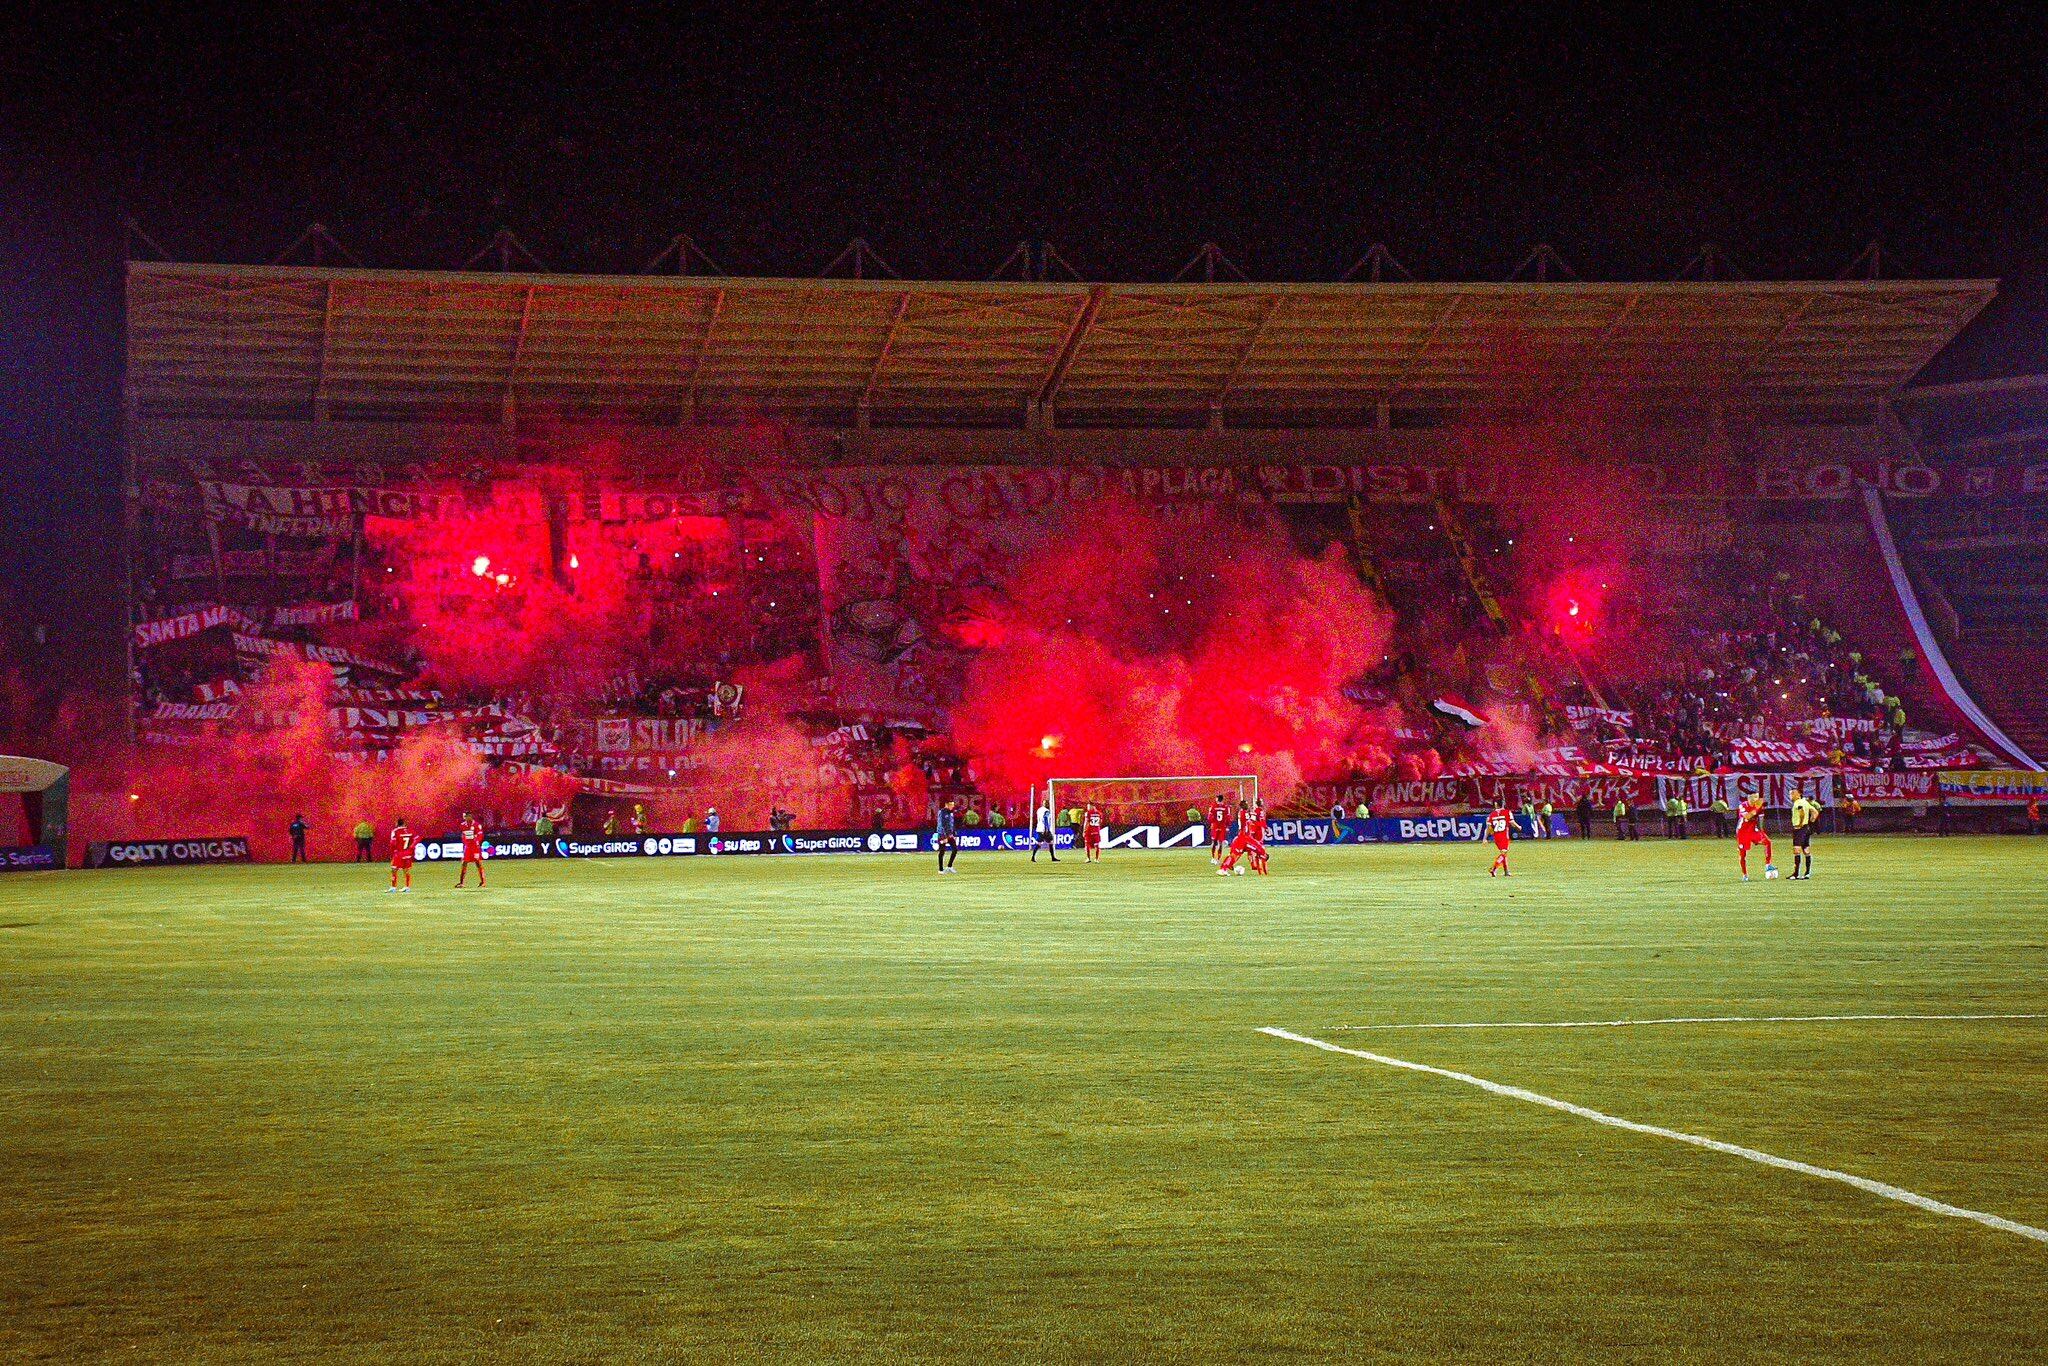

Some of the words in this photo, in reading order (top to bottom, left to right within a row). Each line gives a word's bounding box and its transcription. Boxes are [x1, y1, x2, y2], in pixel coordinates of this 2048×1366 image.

[1142, 467, 1234, 495] PLAGA
[136, 612, 201, 648] SANTA
[1372, 780, 1457, 805] CANCHAS
[1666, 777, 1728, 808] NADA
[1737, 775, 1785, 806] SIN
[1090, 816, 1101, 827] 32
[1400, 818, 1482, 841] BetPlay
[988, 835, 997, 847] Y
[1100, 825, 1205, 848] KIA
[1263, 820, 1329, 844] etPlay
[110, 844, 168, 861] GOLTY
[173, 841, 247, 859] ORIGEN
[402, 837, 410, 850] 7
[541, 843, 550, 854] Y
[569, 841, 638, 855] SuperGIROS
[768, 838, 777, 850] Y
[795, 837, 861, 851] SuperGIROS
